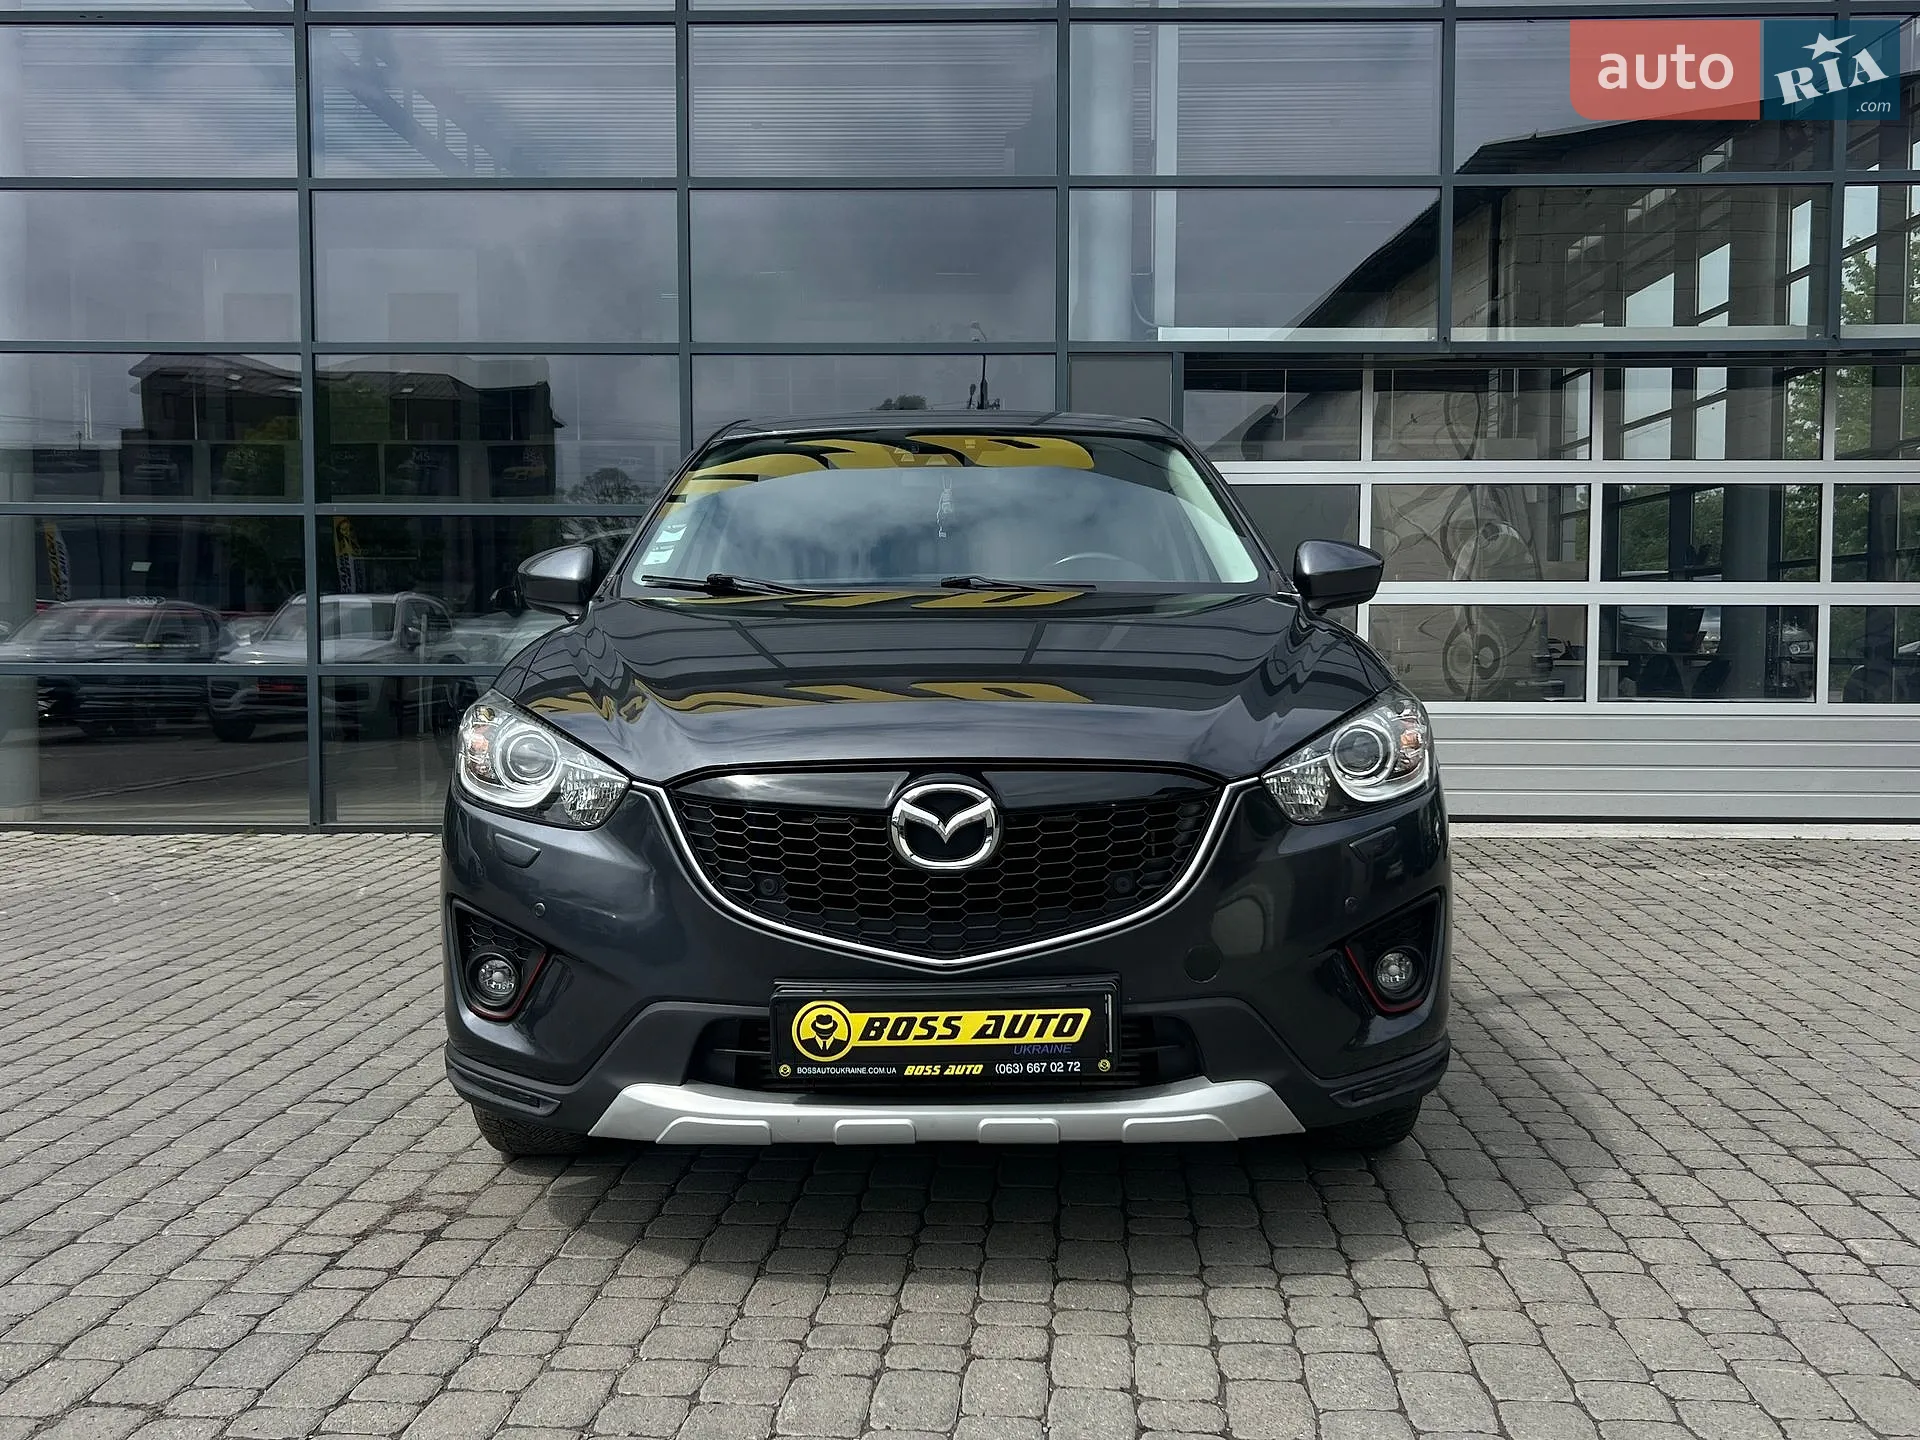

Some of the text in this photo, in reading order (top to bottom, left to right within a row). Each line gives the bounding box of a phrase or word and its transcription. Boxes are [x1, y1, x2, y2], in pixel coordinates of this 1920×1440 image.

[858, 1013, 1083, 1041] BOSS AUTO
[1013, 1044, 1072, 1055] UKRAINE
[797, 1066, 897, 1075] BOSSAUTOUKRAINE.COM.UA
[903, 1064, 984, 1076] BOSS AUTO
[995, 1061, 1081, 1075] (063) 667 02 72
